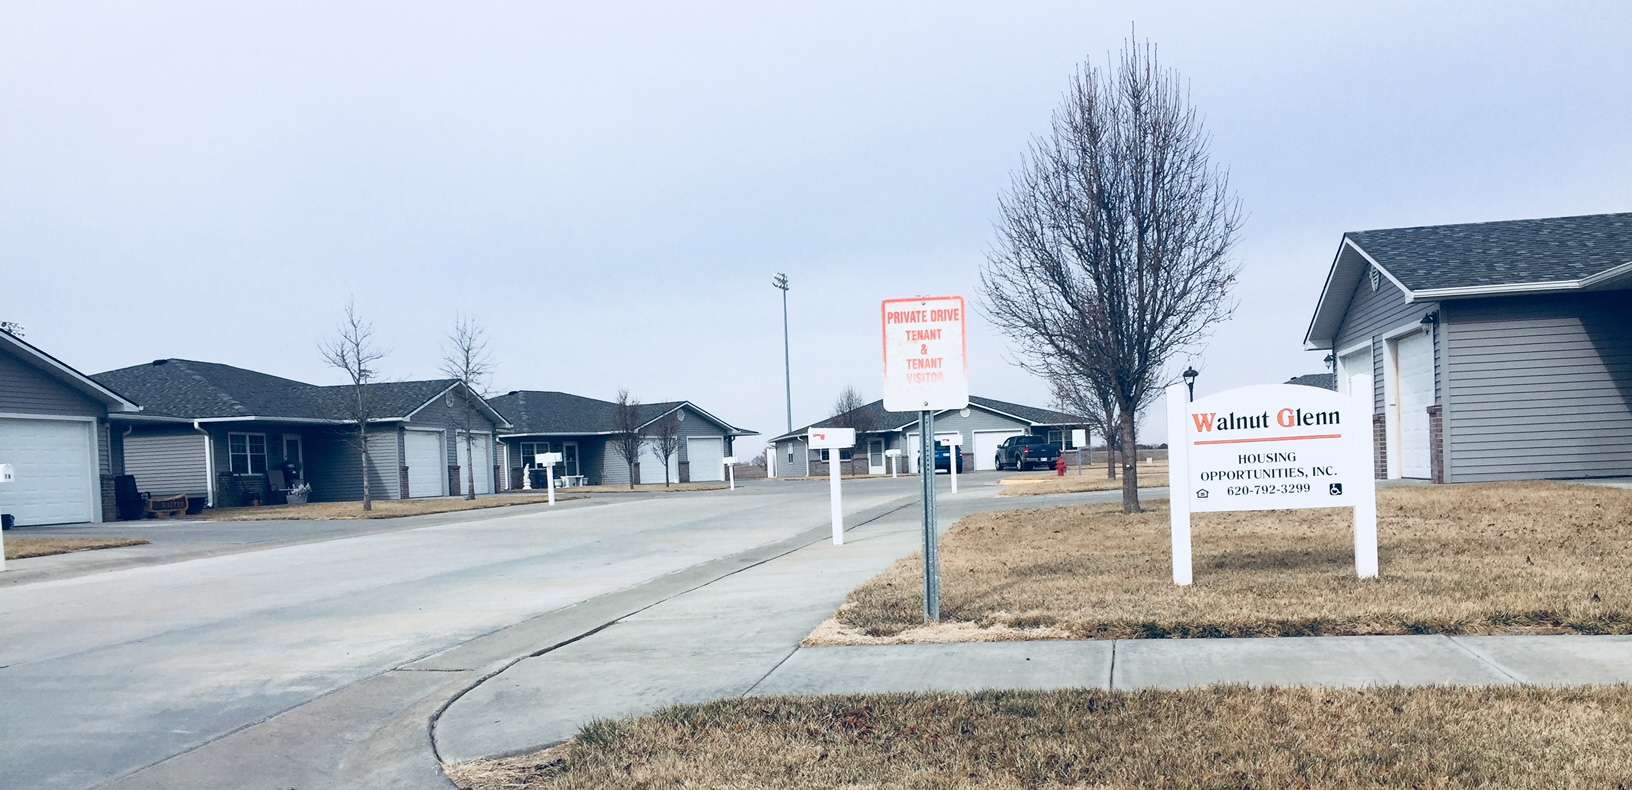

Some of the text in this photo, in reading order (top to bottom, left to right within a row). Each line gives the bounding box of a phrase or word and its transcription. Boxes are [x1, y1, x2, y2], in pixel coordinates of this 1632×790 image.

[887, 308, 959, 324] PRIVATE DRIVE
[905, 329, 942, 341] TENANT
[920, 343, 928, 355] &
[906, 357, 943, 370] TENANT
[1191, 408, 1340, 433] Walnut Glenn
[1238, 451, 1297, 465] HOUSING
[1200, 465, 1338, 481] OPPORTUNITIES, INC.
[1227, 483, 1311, 496] 620-792-3299
